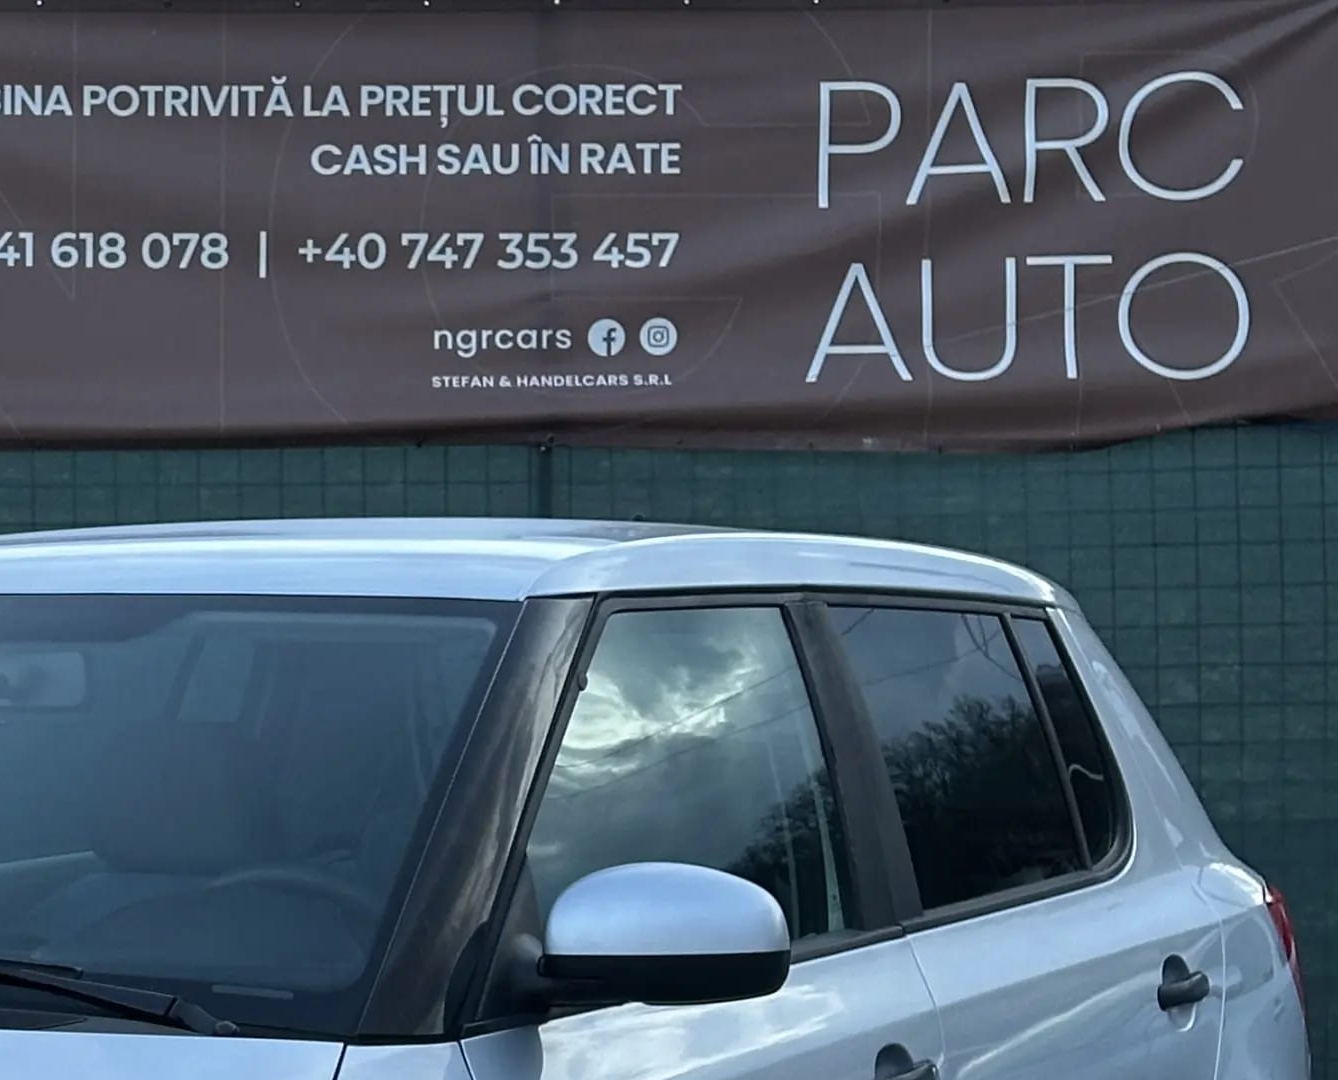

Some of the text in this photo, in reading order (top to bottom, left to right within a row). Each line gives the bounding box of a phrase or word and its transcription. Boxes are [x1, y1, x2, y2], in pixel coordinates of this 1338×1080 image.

[83, 76, 293, 116] POTRIVITĂ
[304, 86, 350, 116] LA
[361, 85, 504, 128] PREȚUL
[513, 84, 682, 115] CORECT
[311, 134, 680, 175] CASH SAU ÎN RATE
[819, 72, 1243, 208] PARC
[51, 232, 126, 268] 618
[142, 233, 228, 269] 078
[299, 233, 386, 269] +40
[402, 233, 484, 269] 747
[498, 233, 578, 269] 353
[593, 233, 679, 268] 457
[806, 253, 1249, 382] AUTO
[434, 330, 571, 358] ngrcars
[432, 376, 494, 387] STEFAN
[499, 376, 511, 387] &
[517, 375, 628, 387] HANDELCARS
